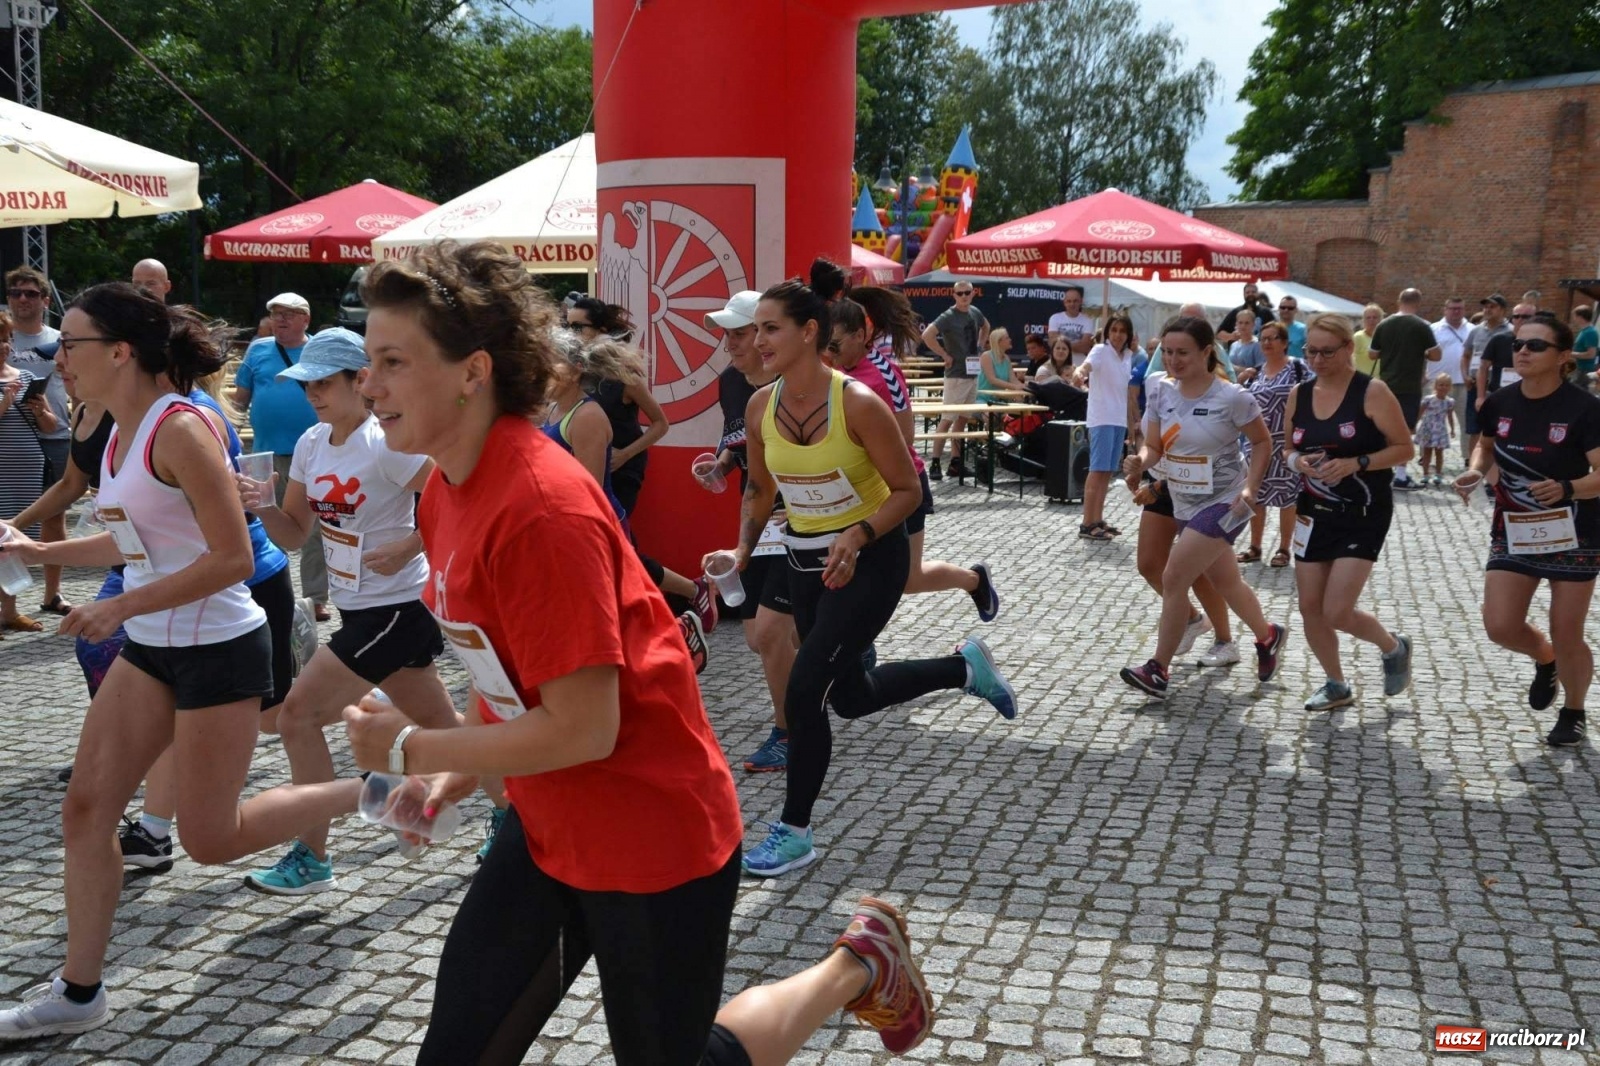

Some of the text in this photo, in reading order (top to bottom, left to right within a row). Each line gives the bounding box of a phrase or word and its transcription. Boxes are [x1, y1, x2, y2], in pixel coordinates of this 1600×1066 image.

[224, 241, 310, 259] RACIBORSKIE
[339, 245, 371, 259] RAC
[513, 243, 597, 262] RACIBO
[956, 248, 1043, 264] RACIBORSKIE
[1066, 247, 1182, 264] RACIBORSKIE
[1211, 252, 1279, 272] RACIBORSKIE
[1007, 287, 1066, 301] SKLEP INTERNETO
[1178, 468, 1190, 479] 20
[805, 489, 824, 501] 15
[1530, 527, 1548, 539] 25
